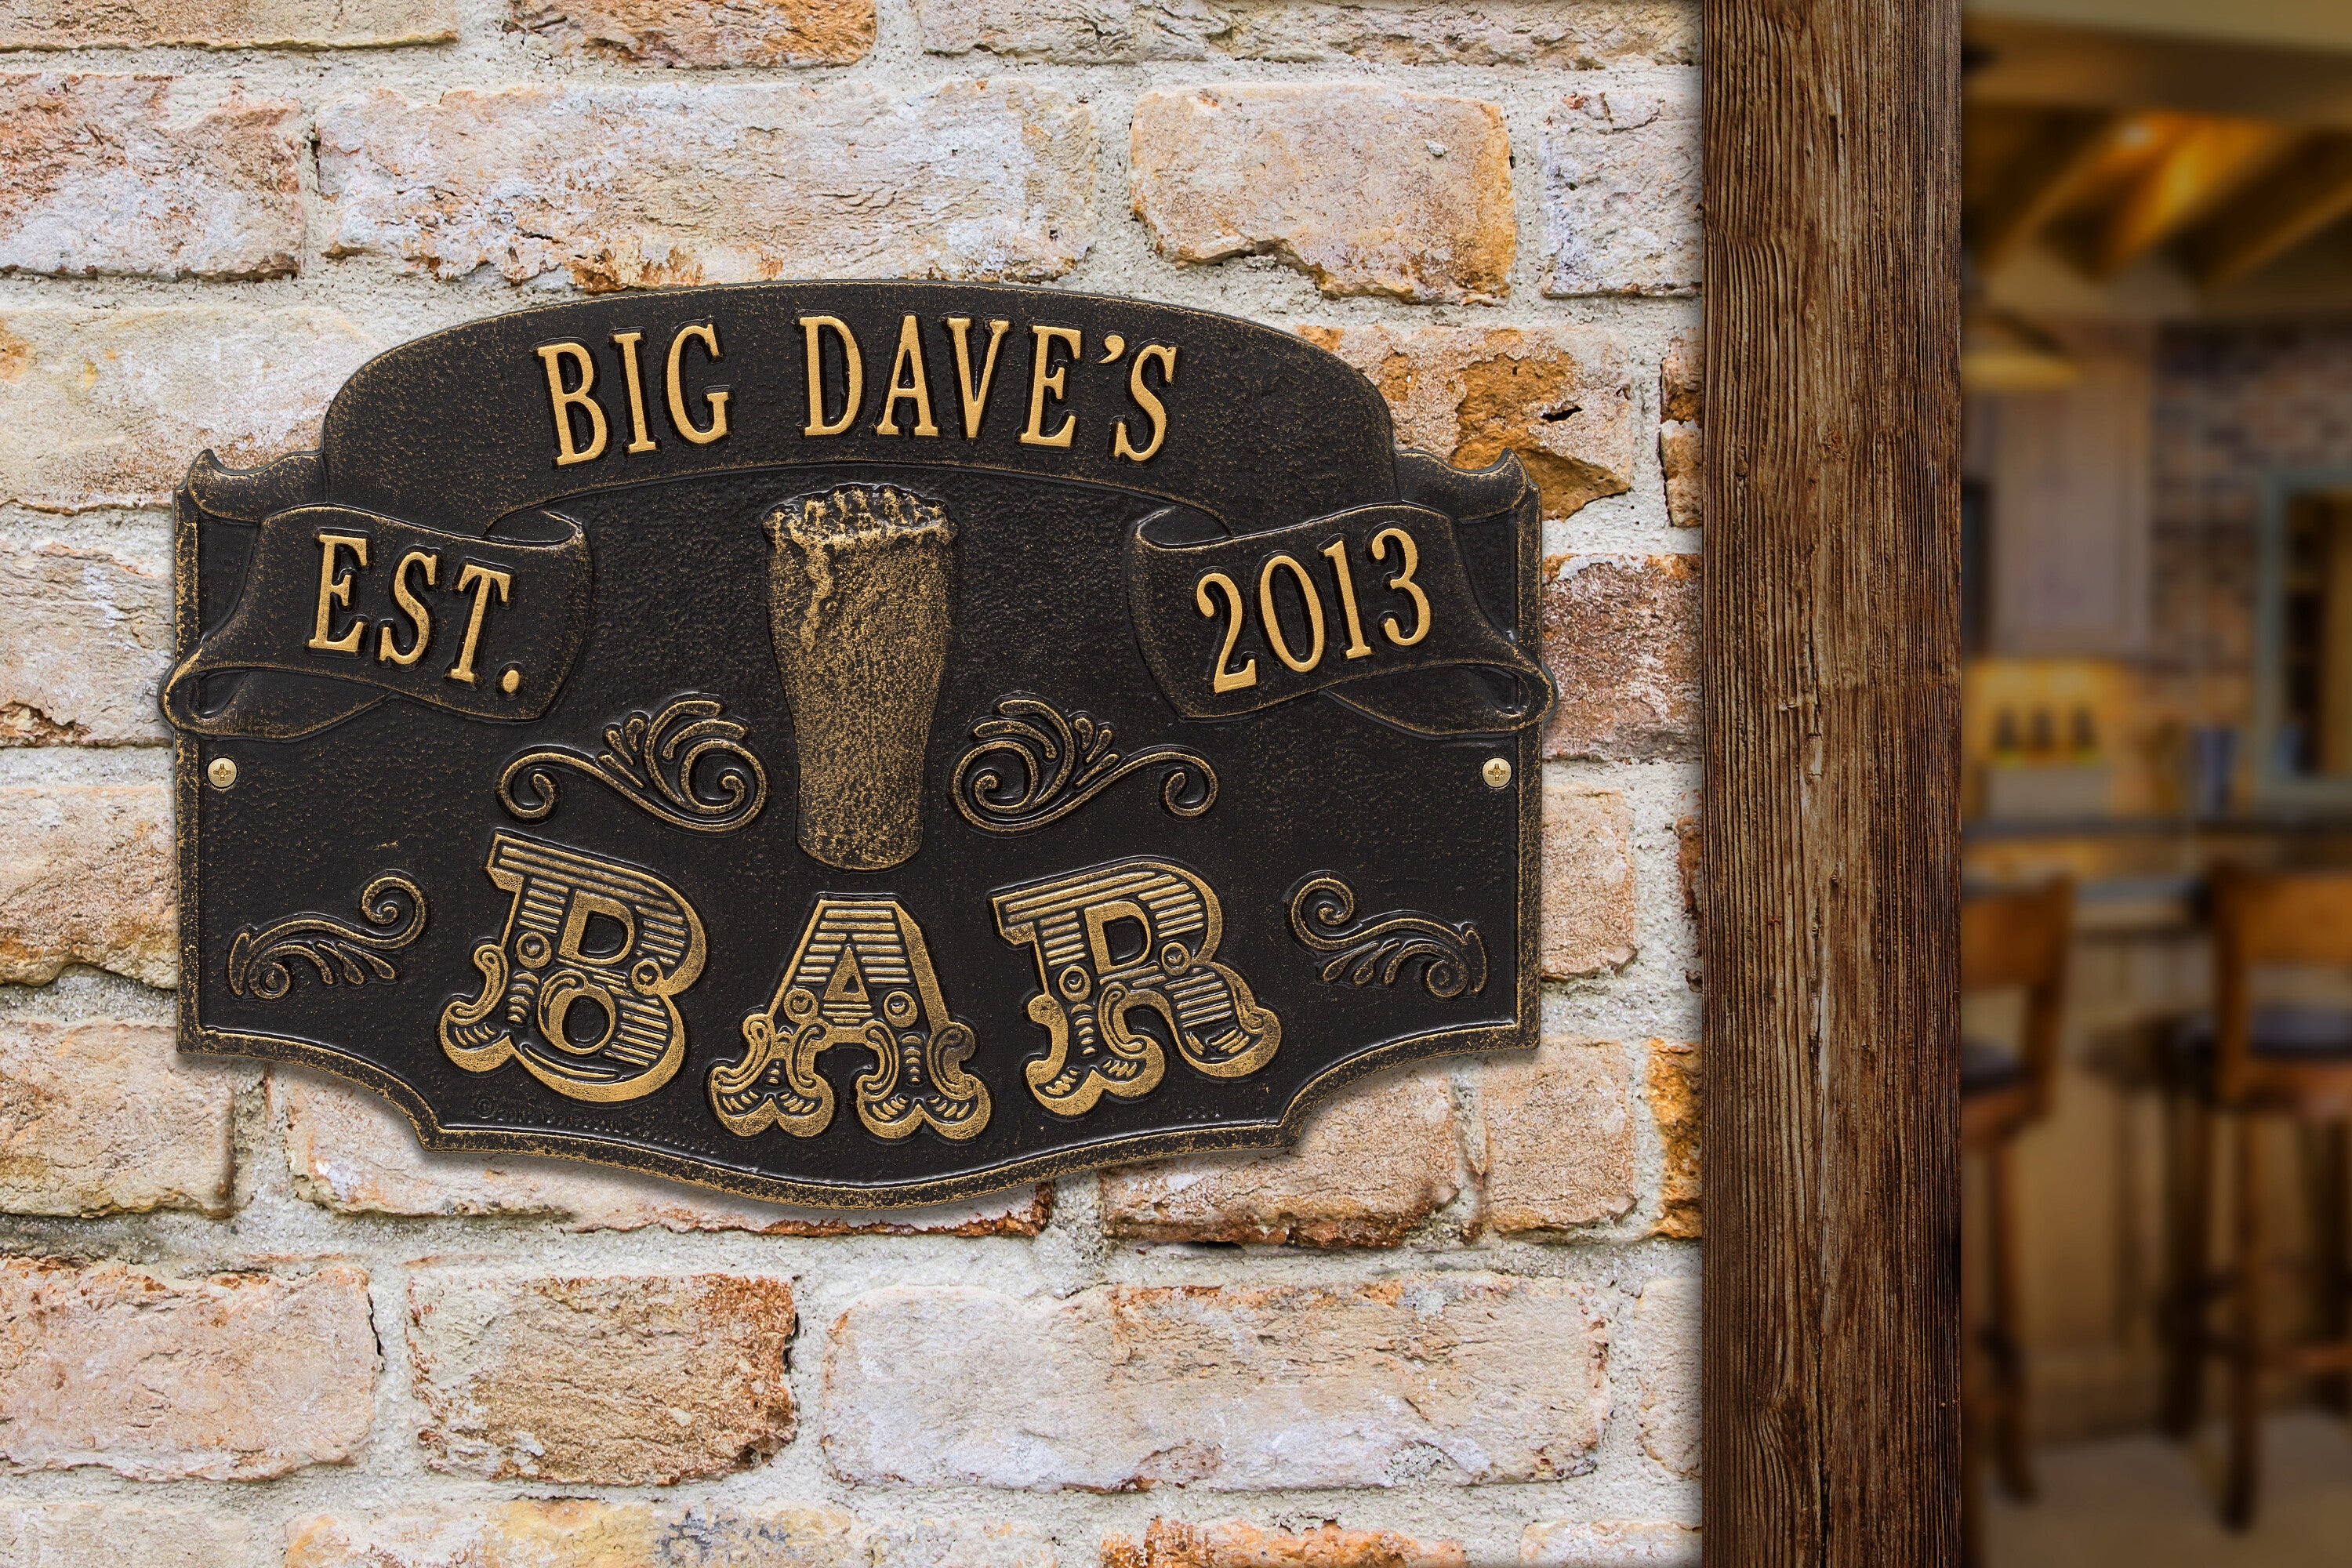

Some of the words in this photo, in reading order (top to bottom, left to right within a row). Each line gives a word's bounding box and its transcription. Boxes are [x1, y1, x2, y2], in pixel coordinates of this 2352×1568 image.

[535, 322, 730, 467] BIG
[798, 314, 1178, 463] DAVE'S
[307, 533, 521, 693] EST.
[1196, 527, 1432, 695] 2013
[437, 831, 1283, 1141] BAR
